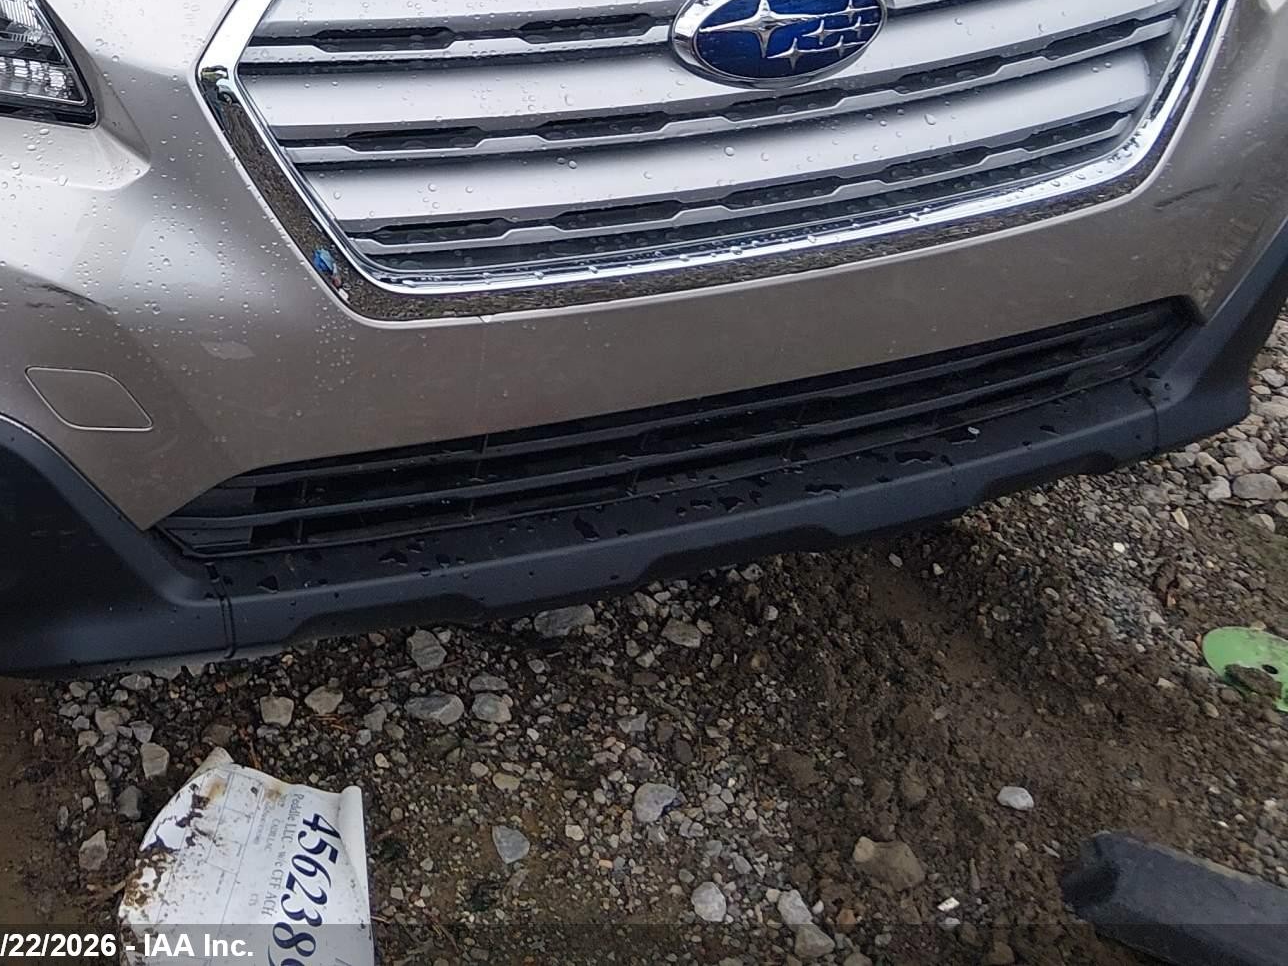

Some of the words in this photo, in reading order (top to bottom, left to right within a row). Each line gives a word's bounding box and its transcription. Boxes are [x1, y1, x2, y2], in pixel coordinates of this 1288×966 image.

[287, 793, 305, 821] Peddle
[281, 822, 297, 843] LLC
[268, 813, 341, 966] 456238
[261, 890, 278, 917] ACH
